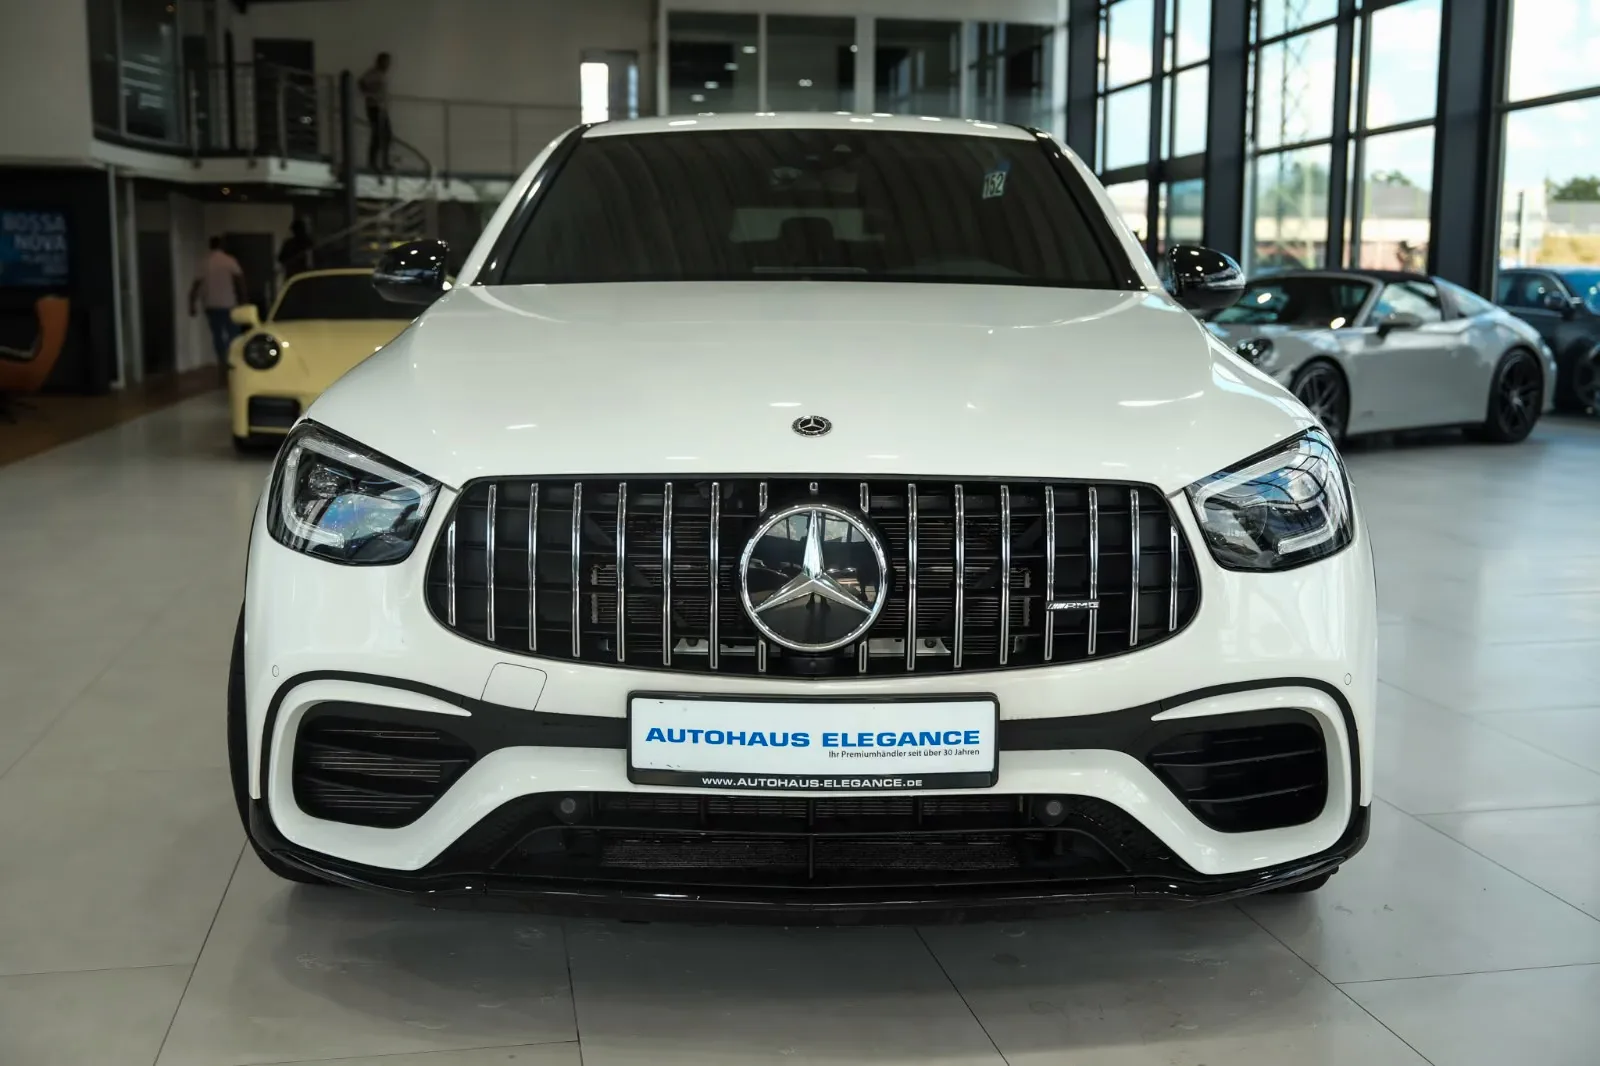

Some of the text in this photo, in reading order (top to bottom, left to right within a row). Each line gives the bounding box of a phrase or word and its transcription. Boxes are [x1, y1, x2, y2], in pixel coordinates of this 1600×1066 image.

[645, 727, 980, 748] AUTOHAUS ELEGANCE
[828, 748, 980, 758] Ihr Premiumhändler seit über 30 Jahren
